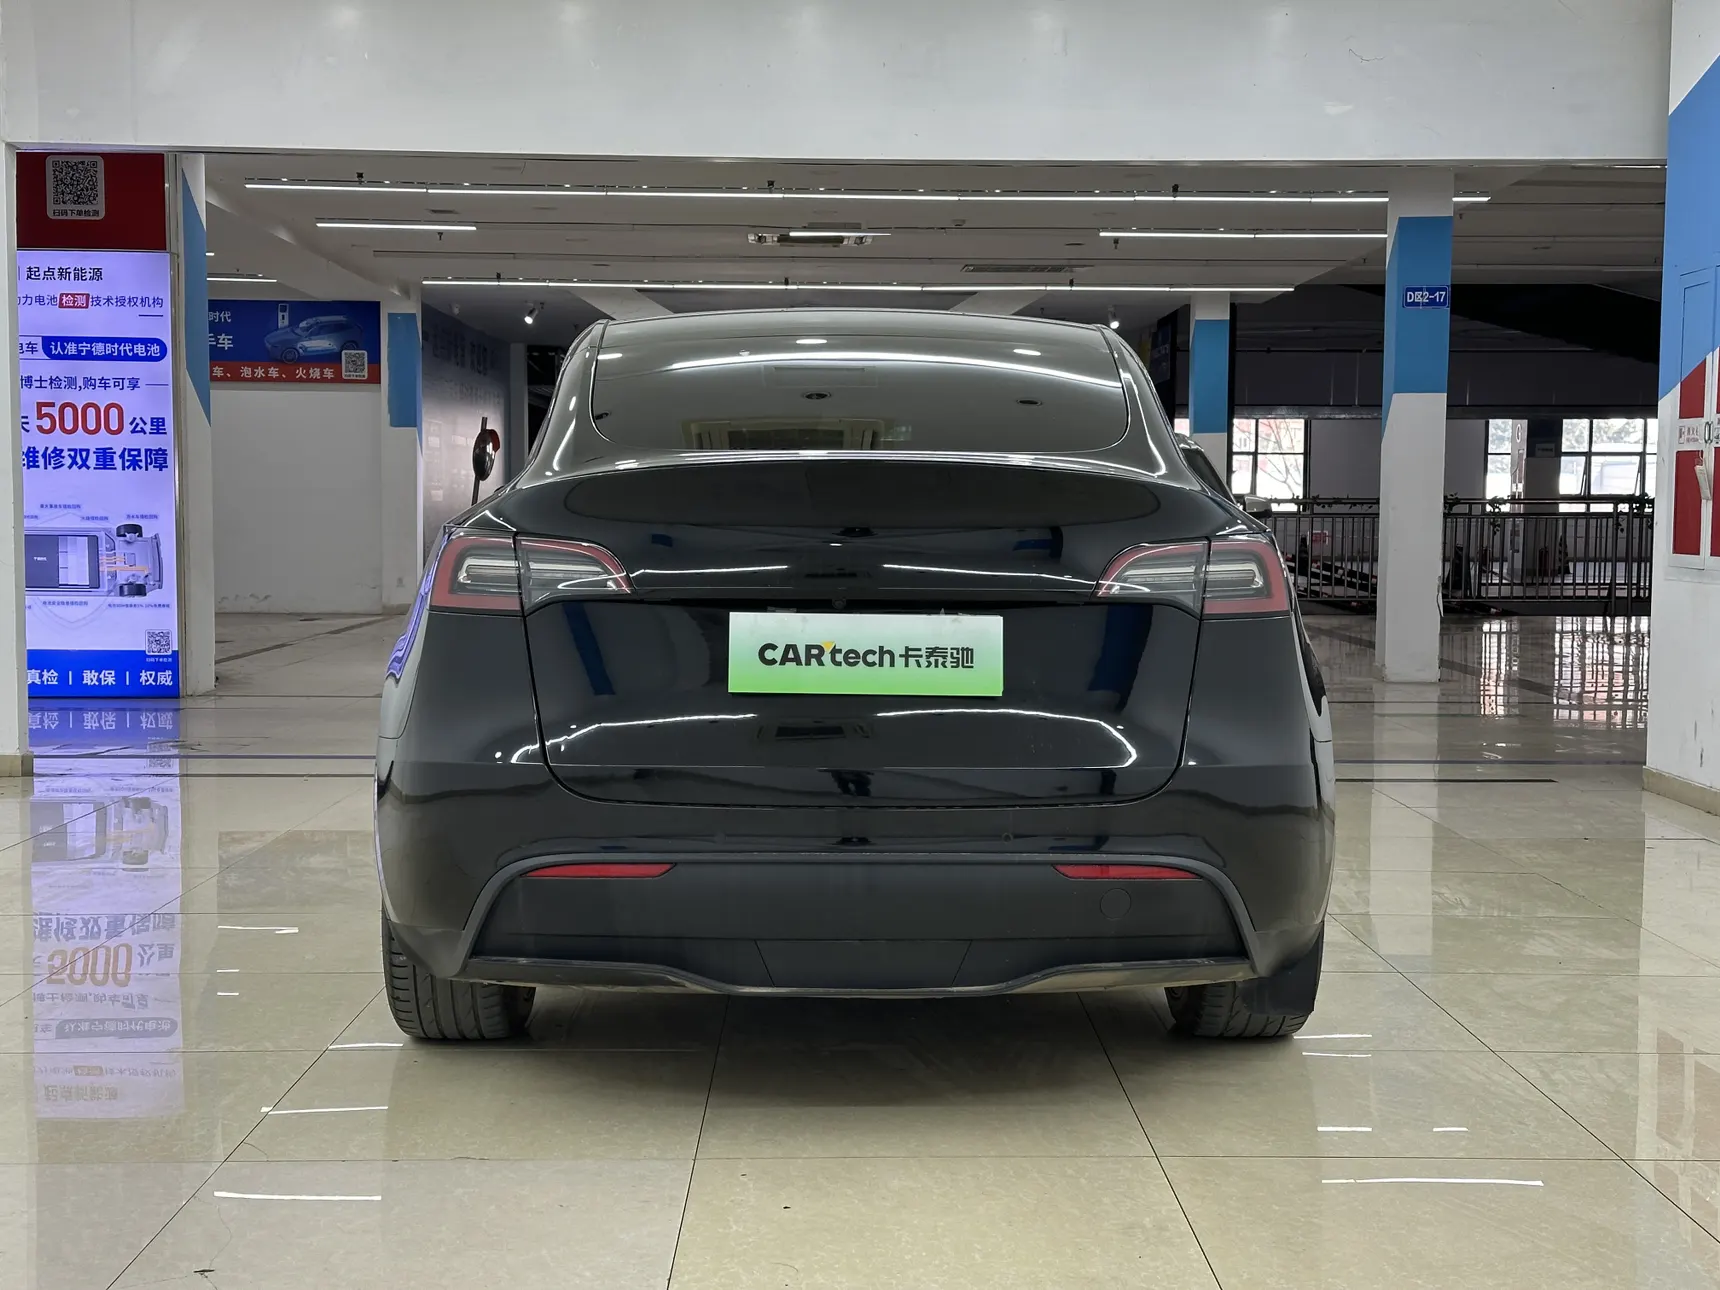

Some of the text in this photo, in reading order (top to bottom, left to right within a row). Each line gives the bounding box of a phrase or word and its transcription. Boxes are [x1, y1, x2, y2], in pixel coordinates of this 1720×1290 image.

[52, 209, 100, 217] 扫码下单检测
[26, 266, 103, 281] 起点新能源
[50, 342, 161, 357] 认准宁德时代电池
[36, 401, 125, 436] 5000
[129, 416, 168, 436] 公里
[899, 645, 975, 669] 卡泰驰
[82, 669, 116, 686] 敢保
[139, 669, 173, 686] 权威
